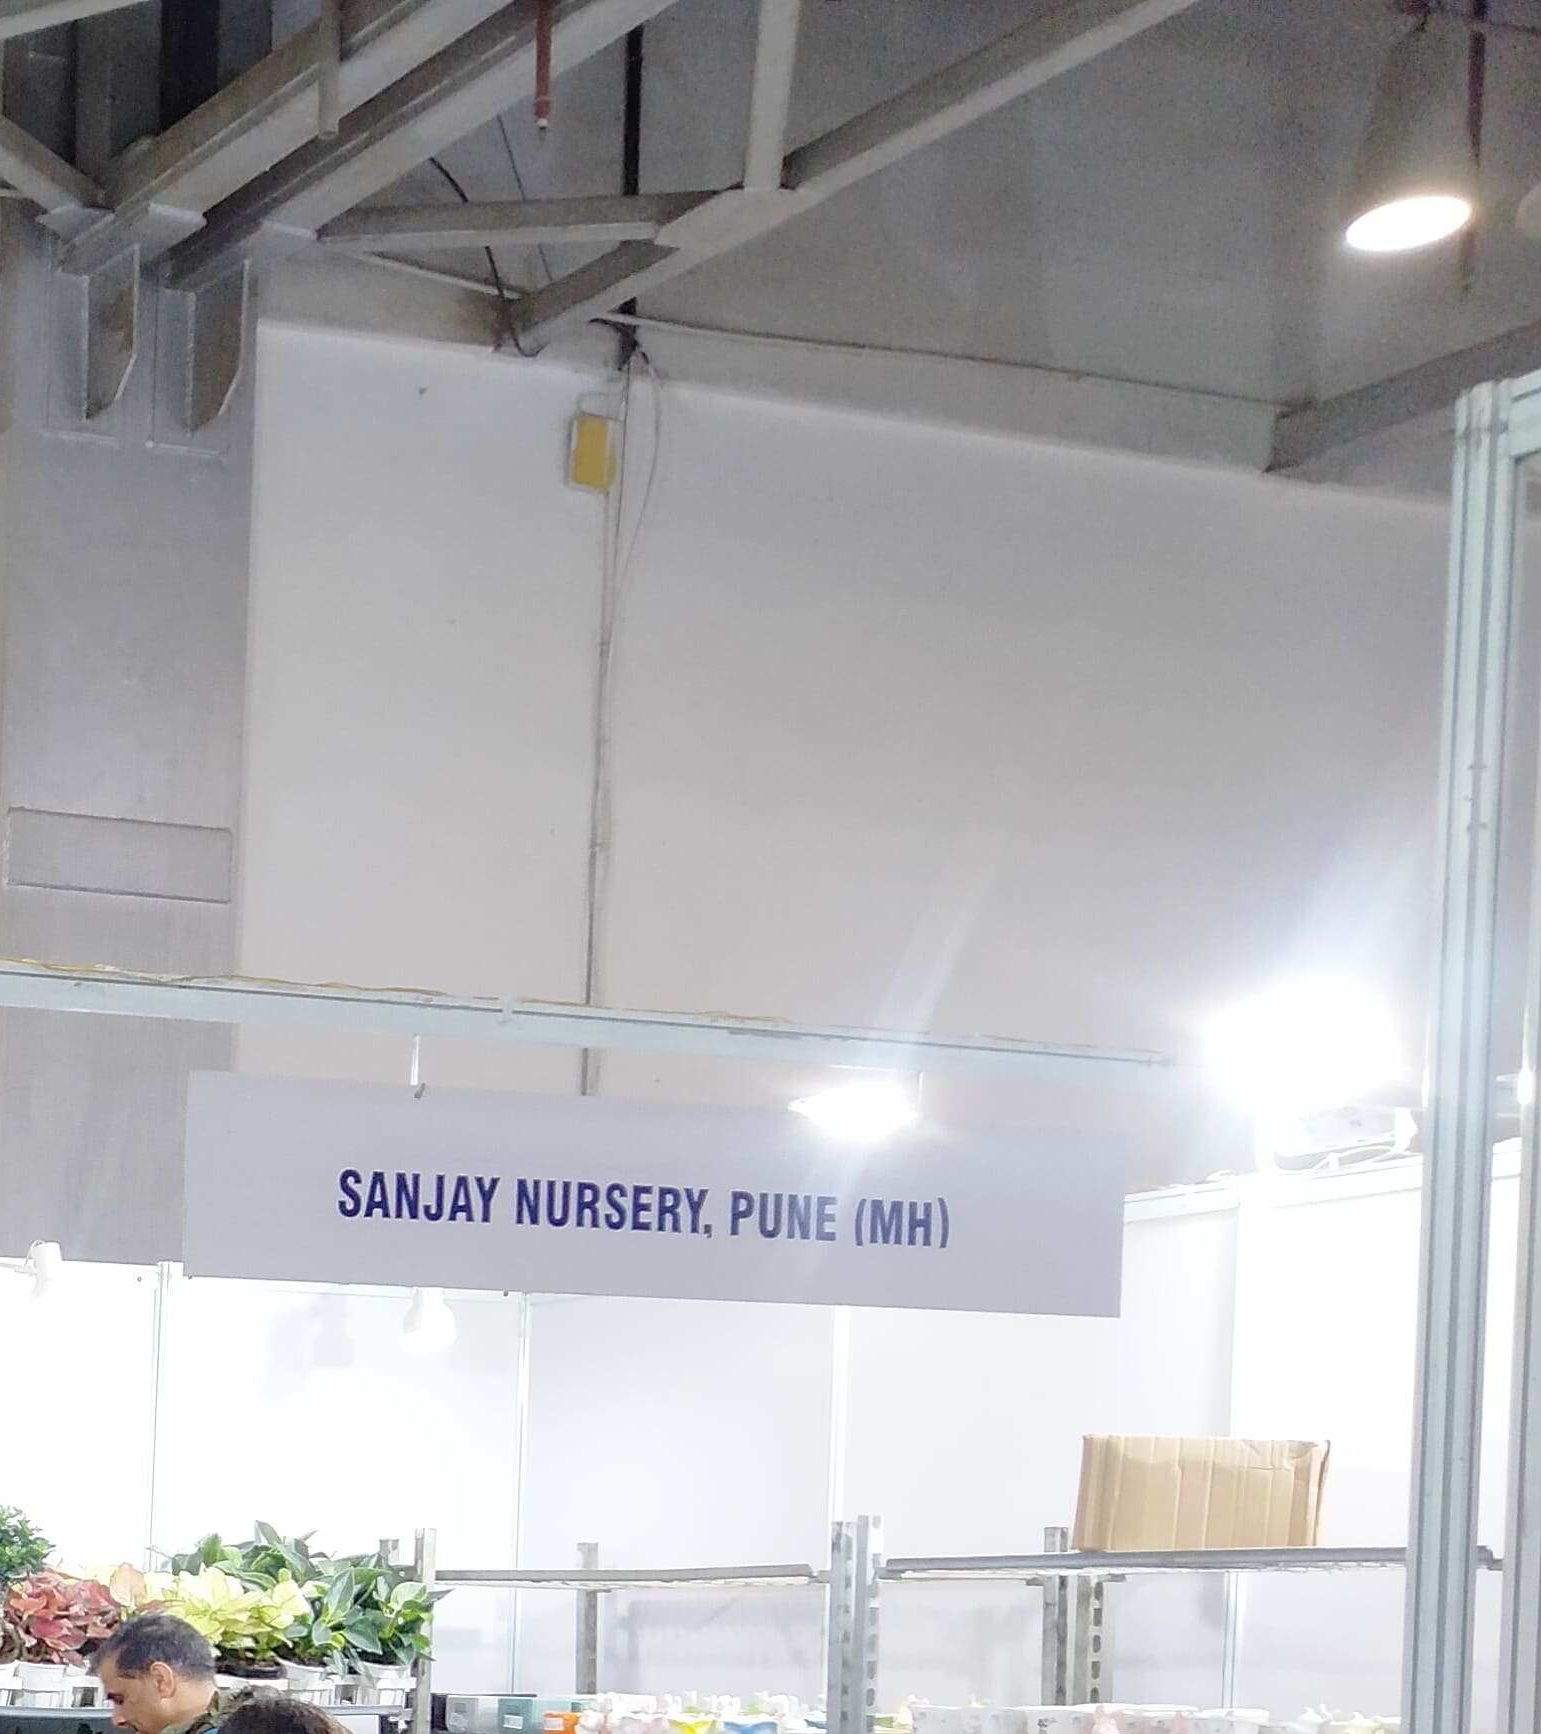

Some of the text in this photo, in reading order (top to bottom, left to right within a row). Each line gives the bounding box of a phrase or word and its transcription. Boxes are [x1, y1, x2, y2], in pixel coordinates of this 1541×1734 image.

[337, 1167, 951, 1249] SANJAY NURSERY, PUNE (MH)
